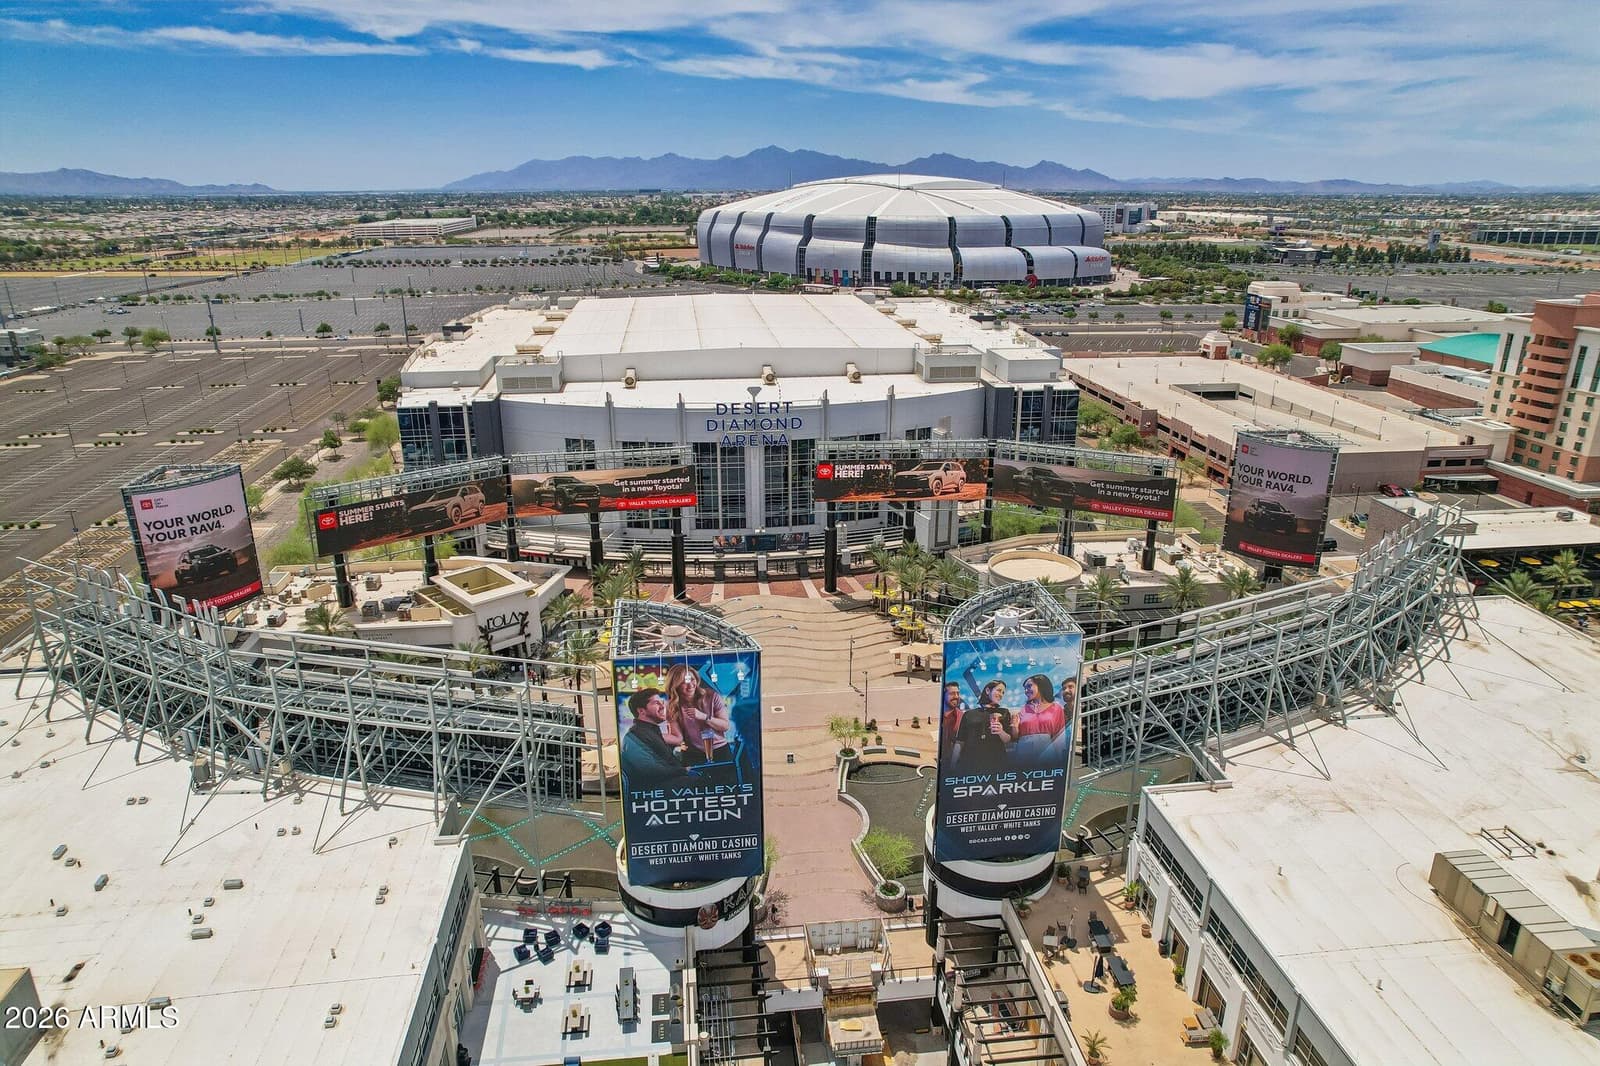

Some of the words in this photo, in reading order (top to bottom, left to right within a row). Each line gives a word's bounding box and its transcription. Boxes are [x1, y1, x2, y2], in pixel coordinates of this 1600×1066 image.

[716, 401, 793, 415] DESERT
[706, 417, 802, 431] DIAMOND
[721, 433, 789, 447] ARENA
[834, 470, 864, 478] HERE!
[1239, 463, 1264, 477] YOUR
[1267, 469, 1313, 485] WORLD.
[613, 479, 629, 487] Get
[629, 478, 661, 486] summer
[654, 484, 682, 492] Toyota!
[1106, 483, 1138, 491] summer
[1140, 487, 1169, 496] started
[1237, 473, 1262, 487] YOUR
[1265, 480, 1297, 494] RAV4.
[1131, 493, 1160, 501] Toyota!
[339, 506, 374, 517] SUMMER
[375, 500, 404, 510] STARTS
[143, 517, 185, 532] YOUR
[187, 505, 235, 523] WORLD.
[339, 512, 373, 526] HERE!
[146, 529, 188, 544] YOUR
[190, 520, 225, 536] RAV4.
[945, 774, 992, 786] SHOW
[996, 772, 1017, 781] US
[1022, 768, 1064, 779] YOUR
[630, 789, 665, 799] THE
[672, 783, 753, 796] VALLEY'S
[953, 779, 1055, 798] SPARKLE
[632, 794, 753, 813] HOTTEST
[645, 808, 741, 825] ACTION
[946, 812, 979, 825] DESERT
[982, 808, 1021, 821] DIAMOND
[1024, 806, 1056, 818] CASINO
[960, 825, 976, 833] WEST
[977, 823, 998, 831] VALLEY
[1003, 821, 1021, 829] WHITE
[631, 843, 669, 856] DESERT
[672, 840, 718, 853] DIAMOND
[721, 836, 758, 849] CASINO
[649, 857, 667, 865] WEST
[668, 855, 692, 864] VALLEY
[699, 853, 719, 862] WHITE
[721, 851, 742, 859] TANKS
